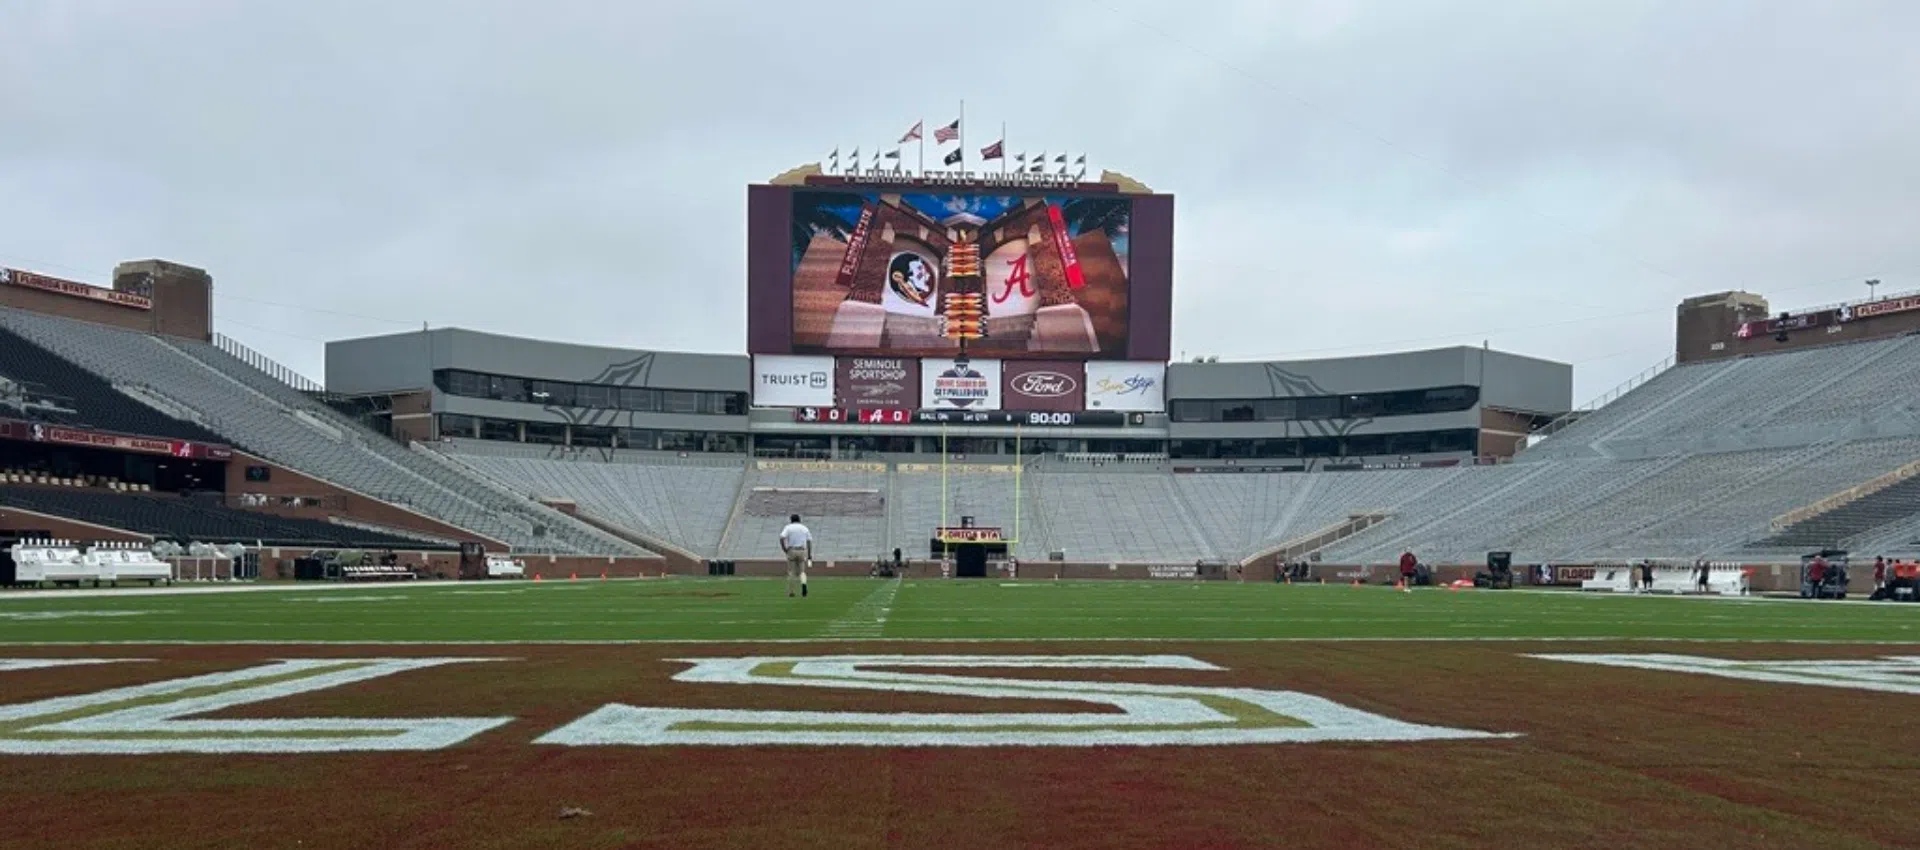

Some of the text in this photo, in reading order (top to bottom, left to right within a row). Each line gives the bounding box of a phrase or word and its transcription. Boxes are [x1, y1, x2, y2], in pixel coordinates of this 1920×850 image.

[843, 169, 1081, 188] FLORIDA STATE UNIVERSITY
[20, 272, 149, 307] FLORIDA STATE ALABAMA
[1859, 301, 1902, 316] FLORIDA
[852, 358, 902, 370] SEMINOLE
[762, 374, 808, 386] TRUIST
[849, 369, 907, 381] SPORTSHOP
[1021, 374, 1064, 393] Ford
[972, 388, 989, 397] OVER
[829, 409, 839, 420] 0
[893, 410, 903, 422] 0
[1029, 412, 1071, 425] 90:00
[1134, 412, 1143, 423] 0
[52, 430, 168, 451] FLORIDA STATE ALABAMA
